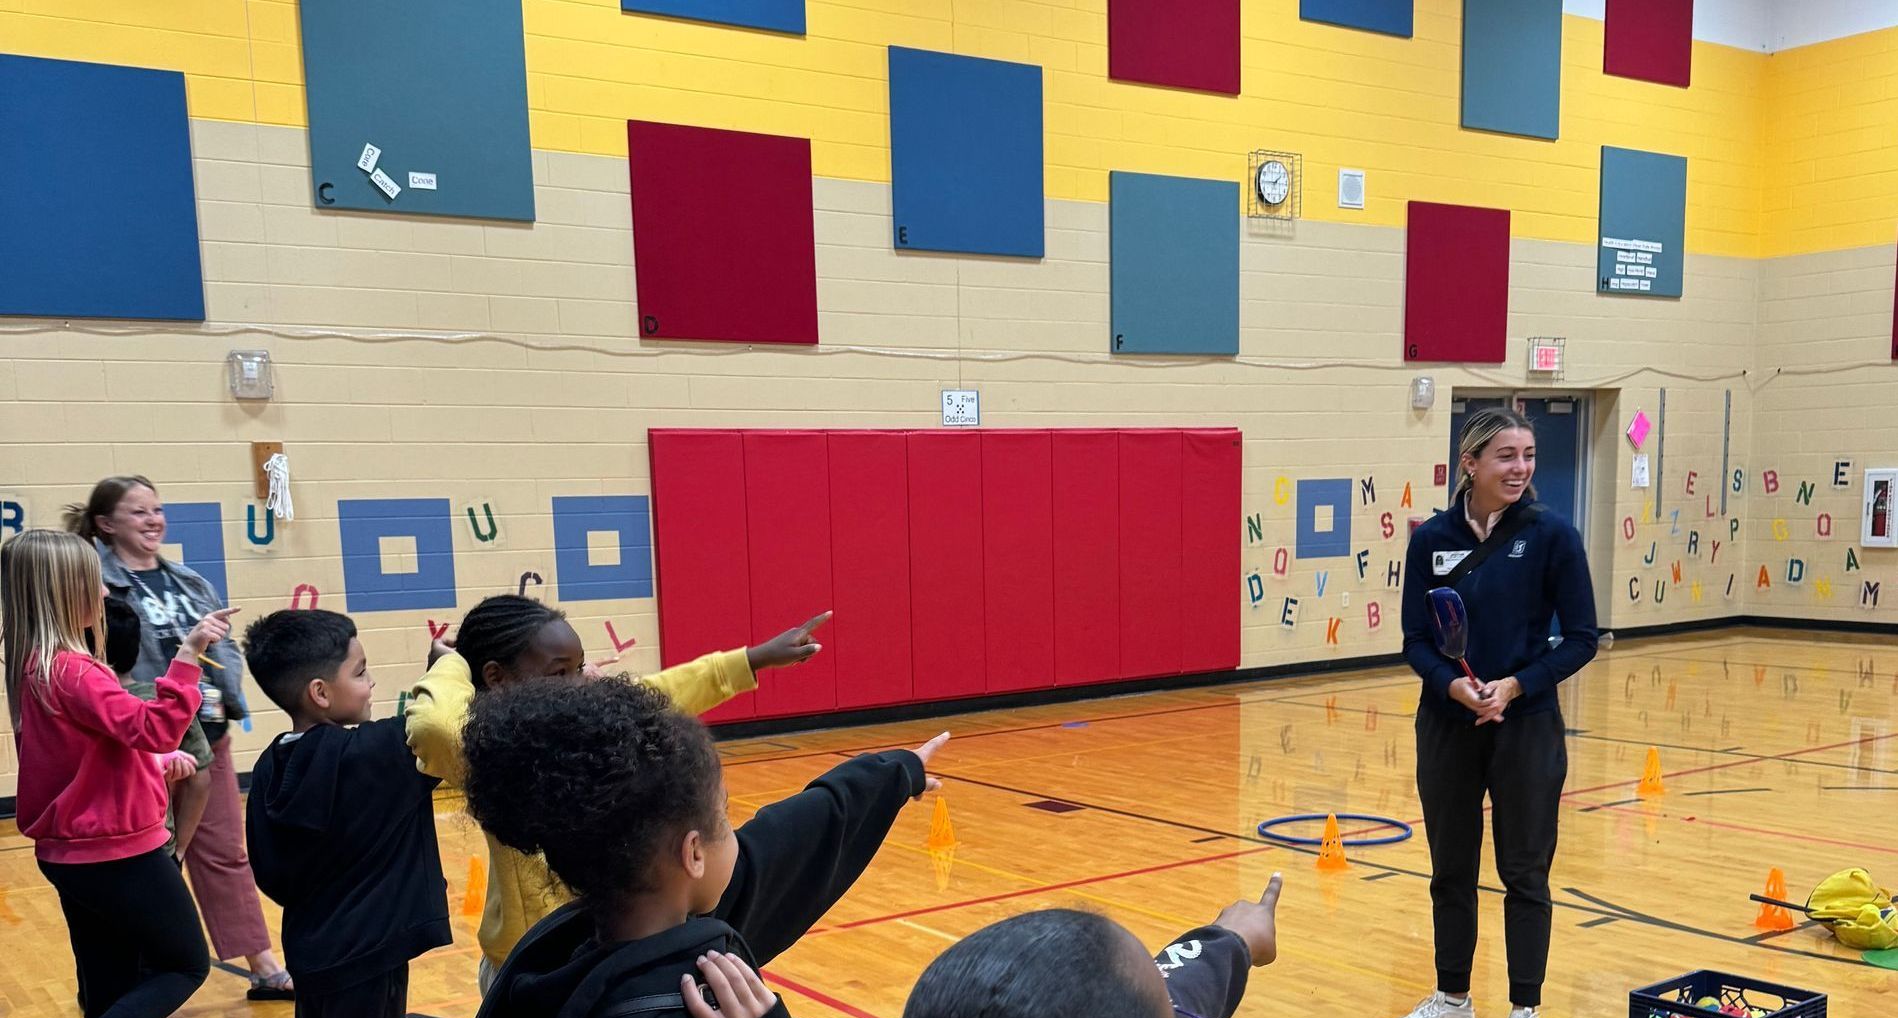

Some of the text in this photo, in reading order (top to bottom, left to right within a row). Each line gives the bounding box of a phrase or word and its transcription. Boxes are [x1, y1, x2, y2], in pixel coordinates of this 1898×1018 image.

[318, 182, 335, 205] C
[898, 226, 908, 244] E
[1601, 277, 1610, 290] H
[643, 315, 659, 334] D
[1116, 334, 1124, 351] F
[1408, 344, 1418, 359] G
[946, 394, 953, 405] 5
[1686, 470, 1698, 495] E
[1732, 469, 1743, 492] S
[1763, 470, 1780, 494] B
[1833, 461, 1850, 486] E
[1361, 476, 1376, 506] M
[1401, 481, 1412, 509] A
[1796, 480, 1815, 506] N
[1706, 494, 1715, 518] L
[247, 504, 275, 545] U
[467, 503, 498, 542] U
[1247, 513, 1263, 543] N
[1381, 511, 1395, 539] S
[1730, 518, 1739, 541] P
[1644, 541, 1656, 564] J
[1688, 530, 1699, 555] R
[1711, 540, 1720, 564] Y
[1357, 549, 1369, 578] F
[1787, 558, 1804, 582] D
[1846, 547, 1860, 571] A
[1315, 570, 1328, 598] V
[1387, 560, 1401, 587] H
[1757, 564, 1770, 588] A
[1247, 573, 1264, 603] D
[1629, 576, 1640, 601] C
[1655, 580, 1665, 603] U
[1862, 580, 1880, 606] M
[1281, 597, 1298, 626] E
[1367, 601, 1381, 628] B
[604, 620, 637, 653] L
[1326, 616, 1341, 645] K
